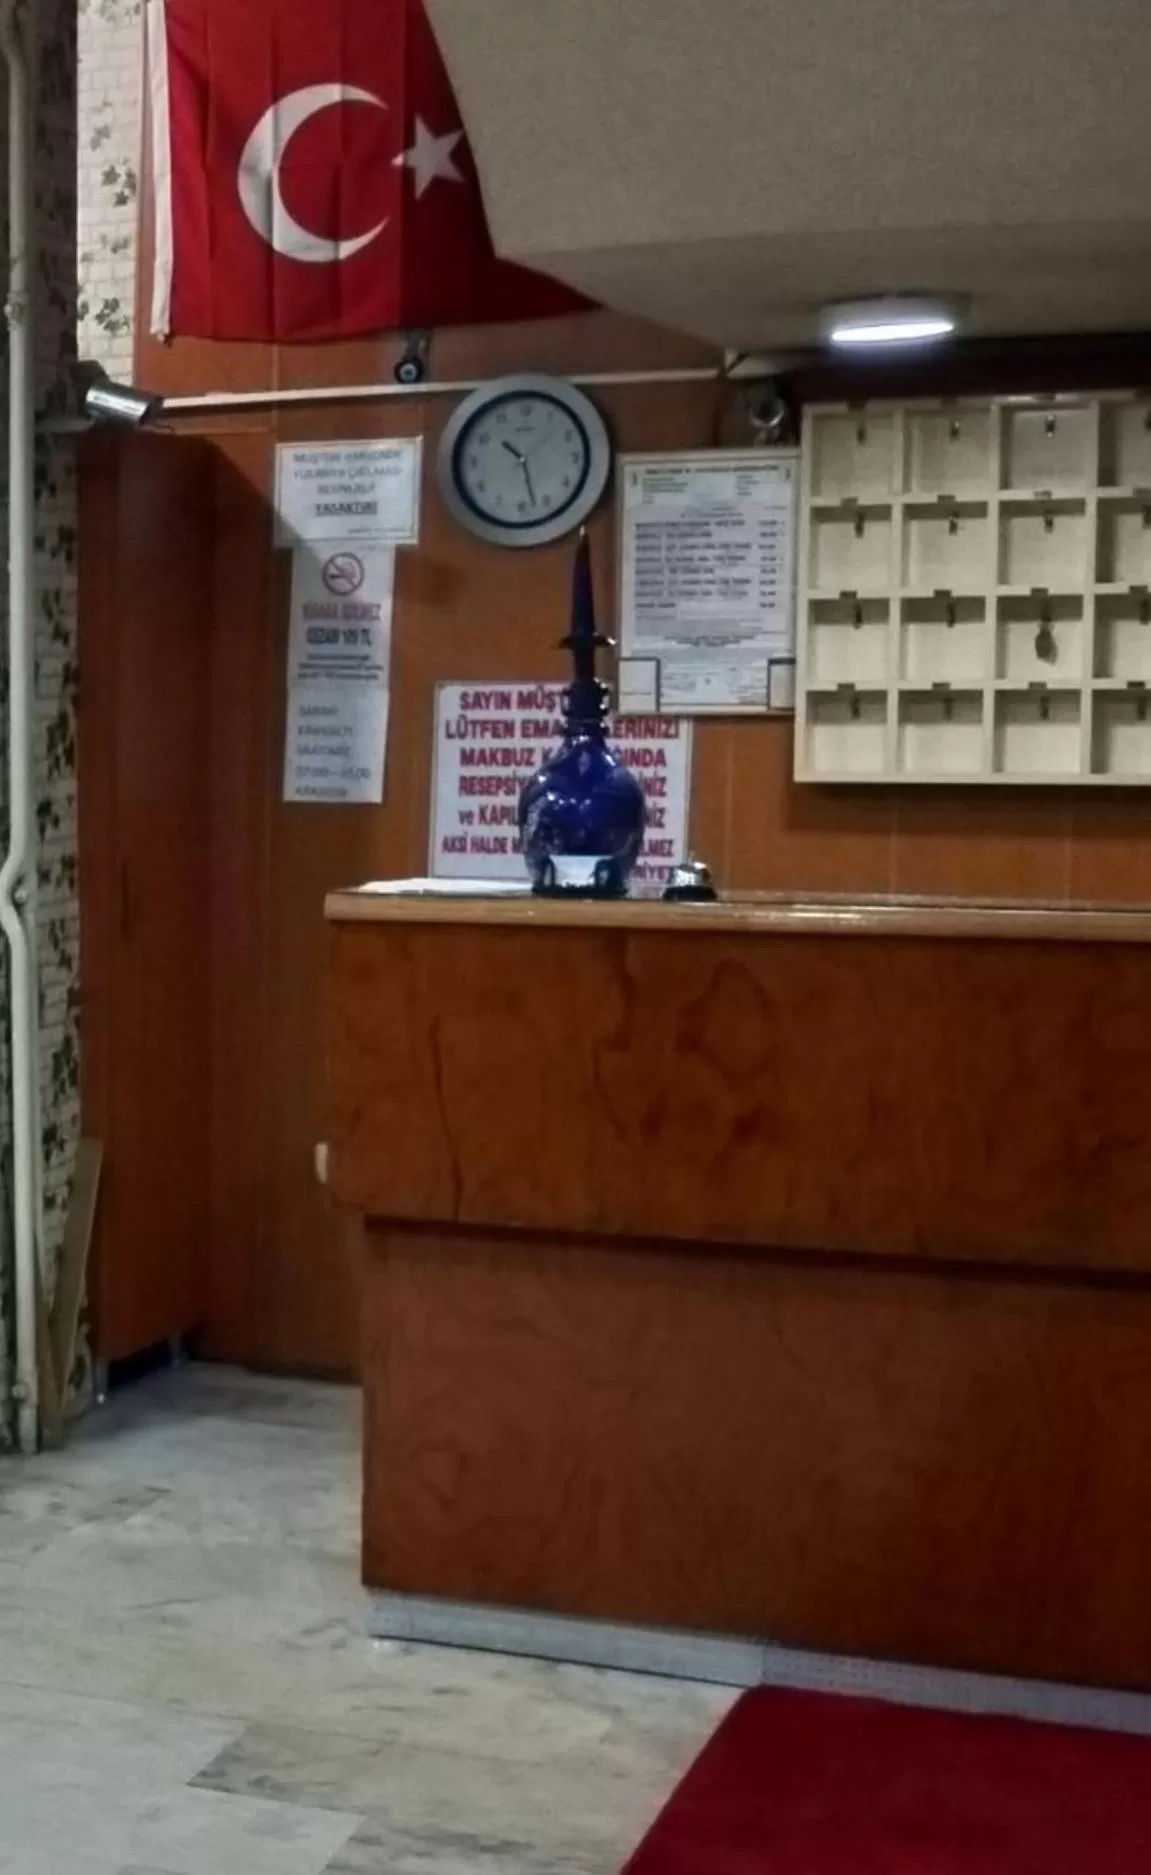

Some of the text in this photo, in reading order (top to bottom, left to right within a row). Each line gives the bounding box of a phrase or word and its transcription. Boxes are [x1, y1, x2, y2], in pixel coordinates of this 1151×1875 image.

[459, 684, 570, 713] SAYIN MÜŞT
[445, 713, 516, 739] LÜTFEN
[459, 747, 535, 767] MAKBUZ
[458, 770, 530, 797] RESEPSİY
[458, 810, 474, 826] ve
[442, 831, 468, 854] AKSİ
[470, 836, 509, 854] HALDE
